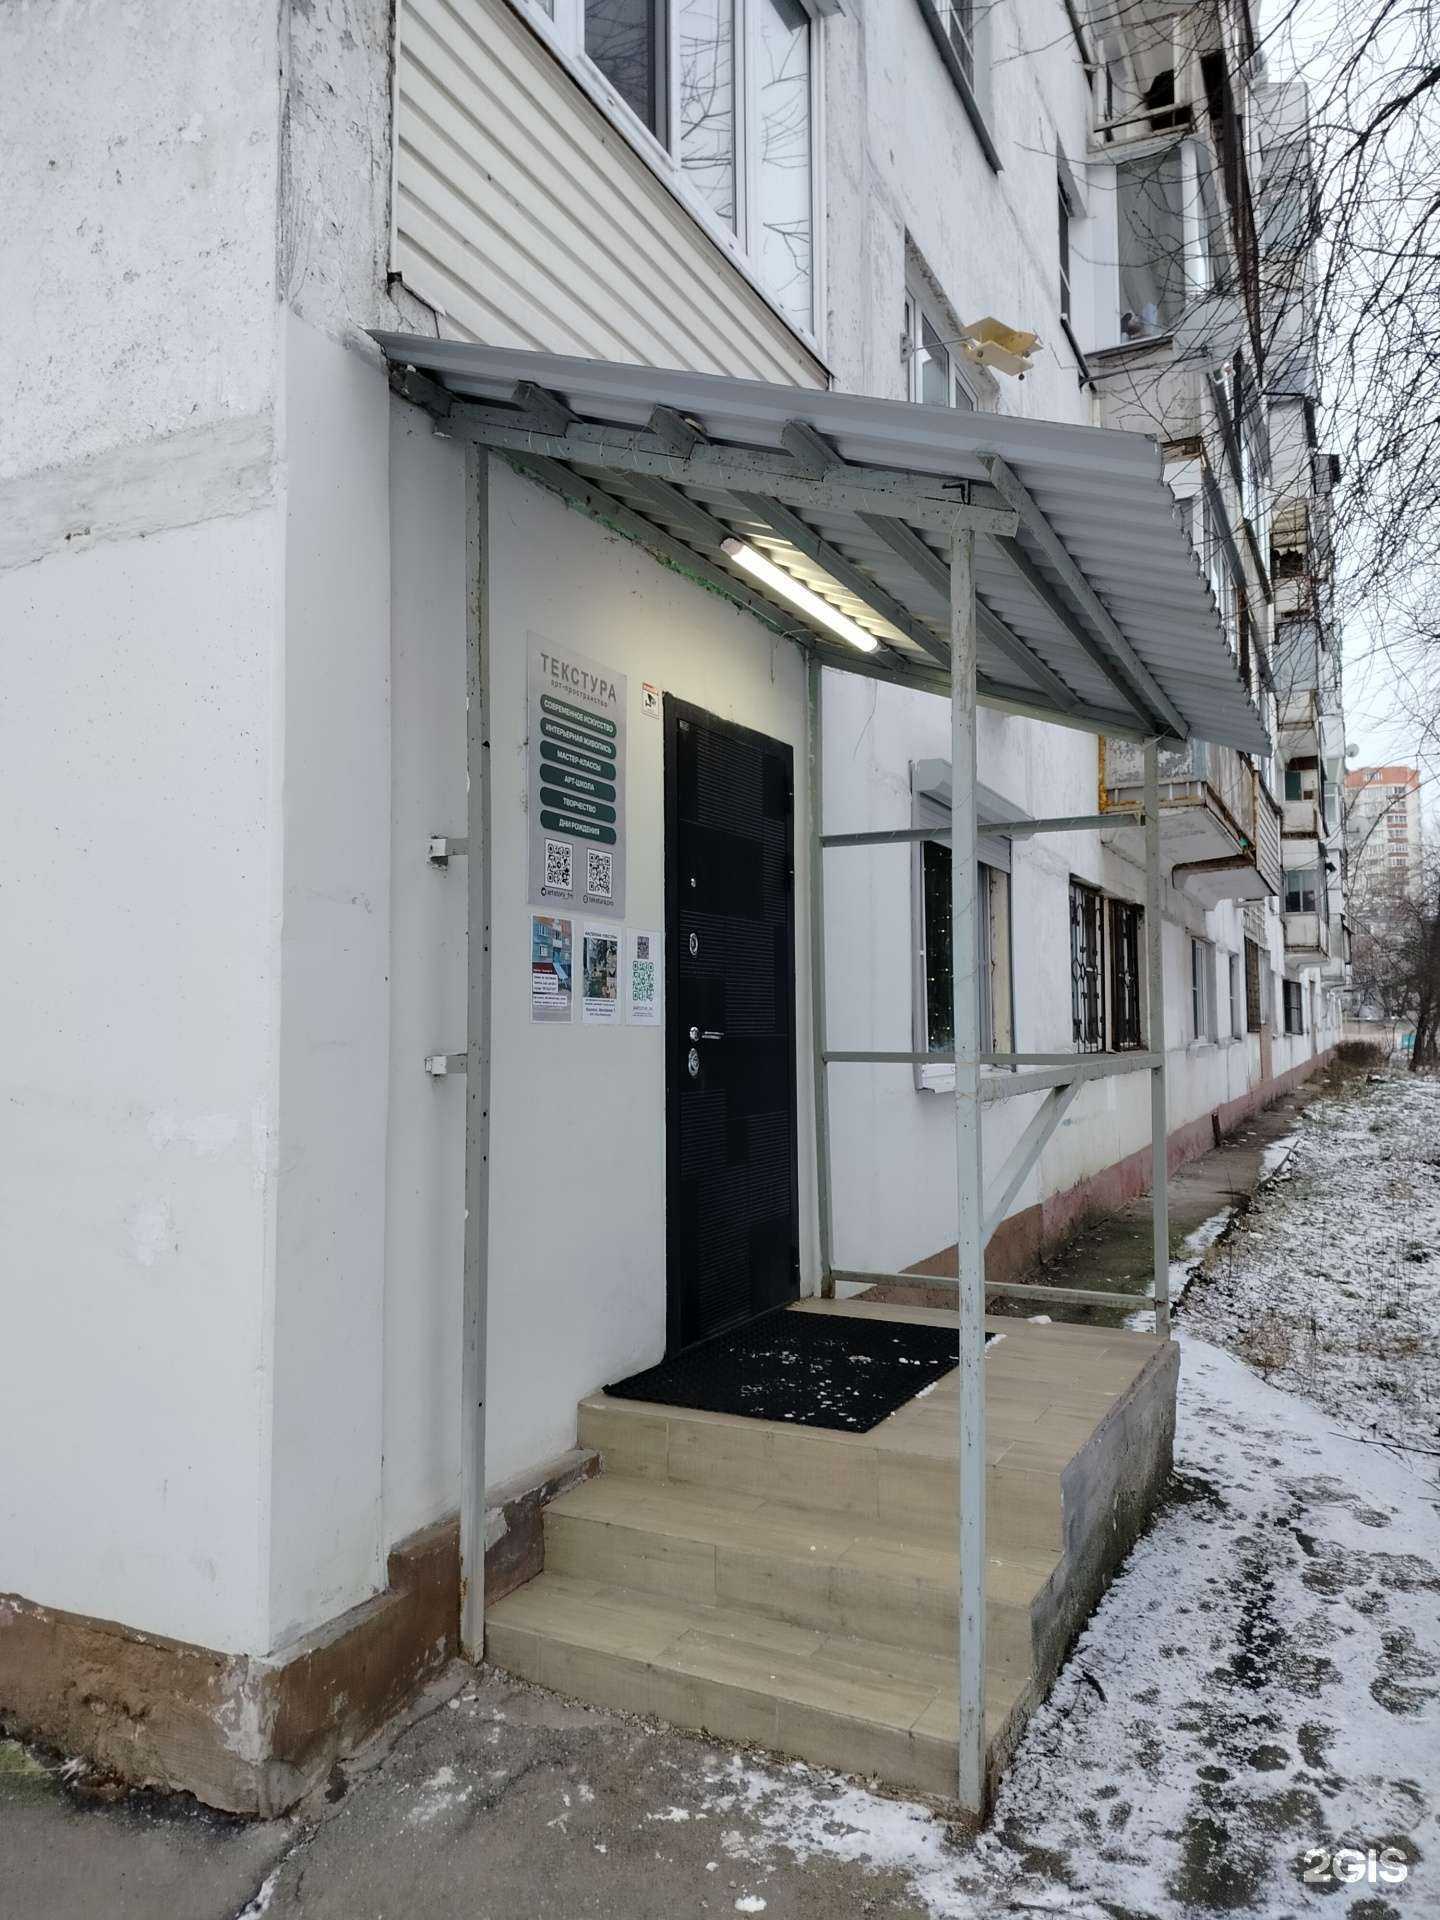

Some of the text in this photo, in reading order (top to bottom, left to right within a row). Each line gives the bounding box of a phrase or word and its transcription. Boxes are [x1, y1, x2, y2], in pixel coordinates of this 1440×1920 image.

[541, 652, 616, 702] ТЕКСТУРА
[544, 700, 614, 733] СОВРЕМЕННОЕ ИСКУССТВО
[545, 723, 612, 754] ИНТЕРЬЕРНАЯ ЖИВОПИСЬ
[557, 750, 601, 771] МАСТЕР-КЛАССЫ
[564, 775, 595, 791] АРТ-ШКОЛА
[563, 797, 597, 813] ТВОРЧЕСТВО
[559, 818, 600, 836] ДНИ РОЖДЕНИЯ
